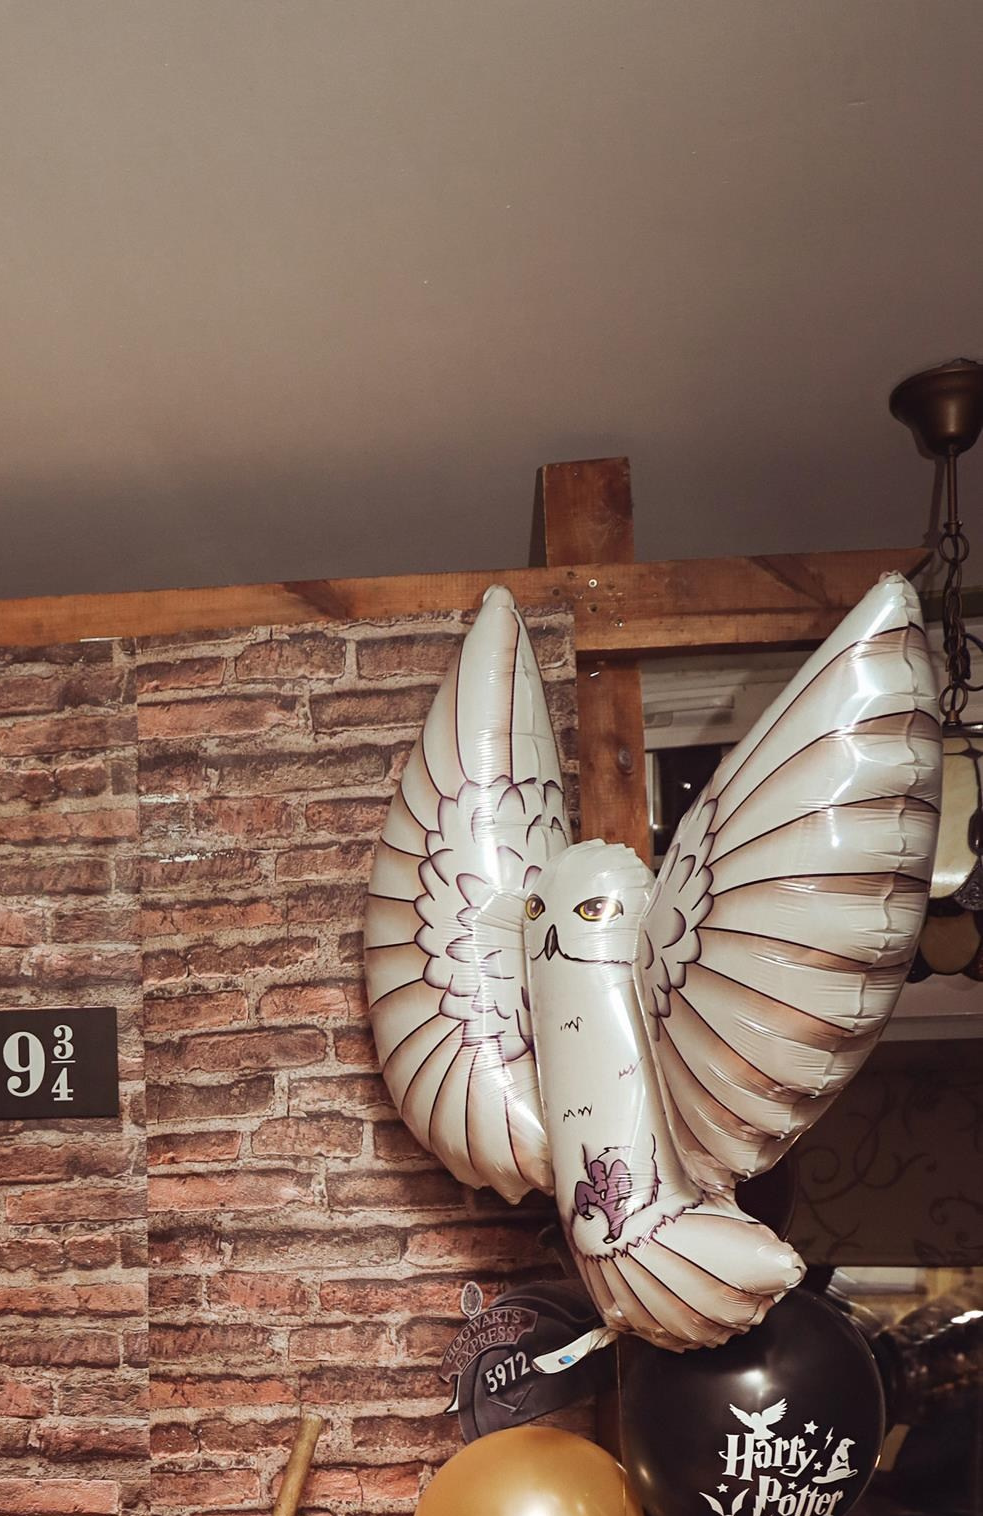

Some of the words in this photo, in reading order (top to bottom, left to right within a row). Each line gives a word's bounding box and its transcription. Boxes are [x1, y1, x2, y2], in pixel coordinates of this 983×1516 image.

[445, 1309, 522, 1364] HOGWARTS
[456, 1325, 517, 1373] EXPRESS
[484, 1351, 531, 1393] 5972
[719, 1432, 818, 1482] Harry
